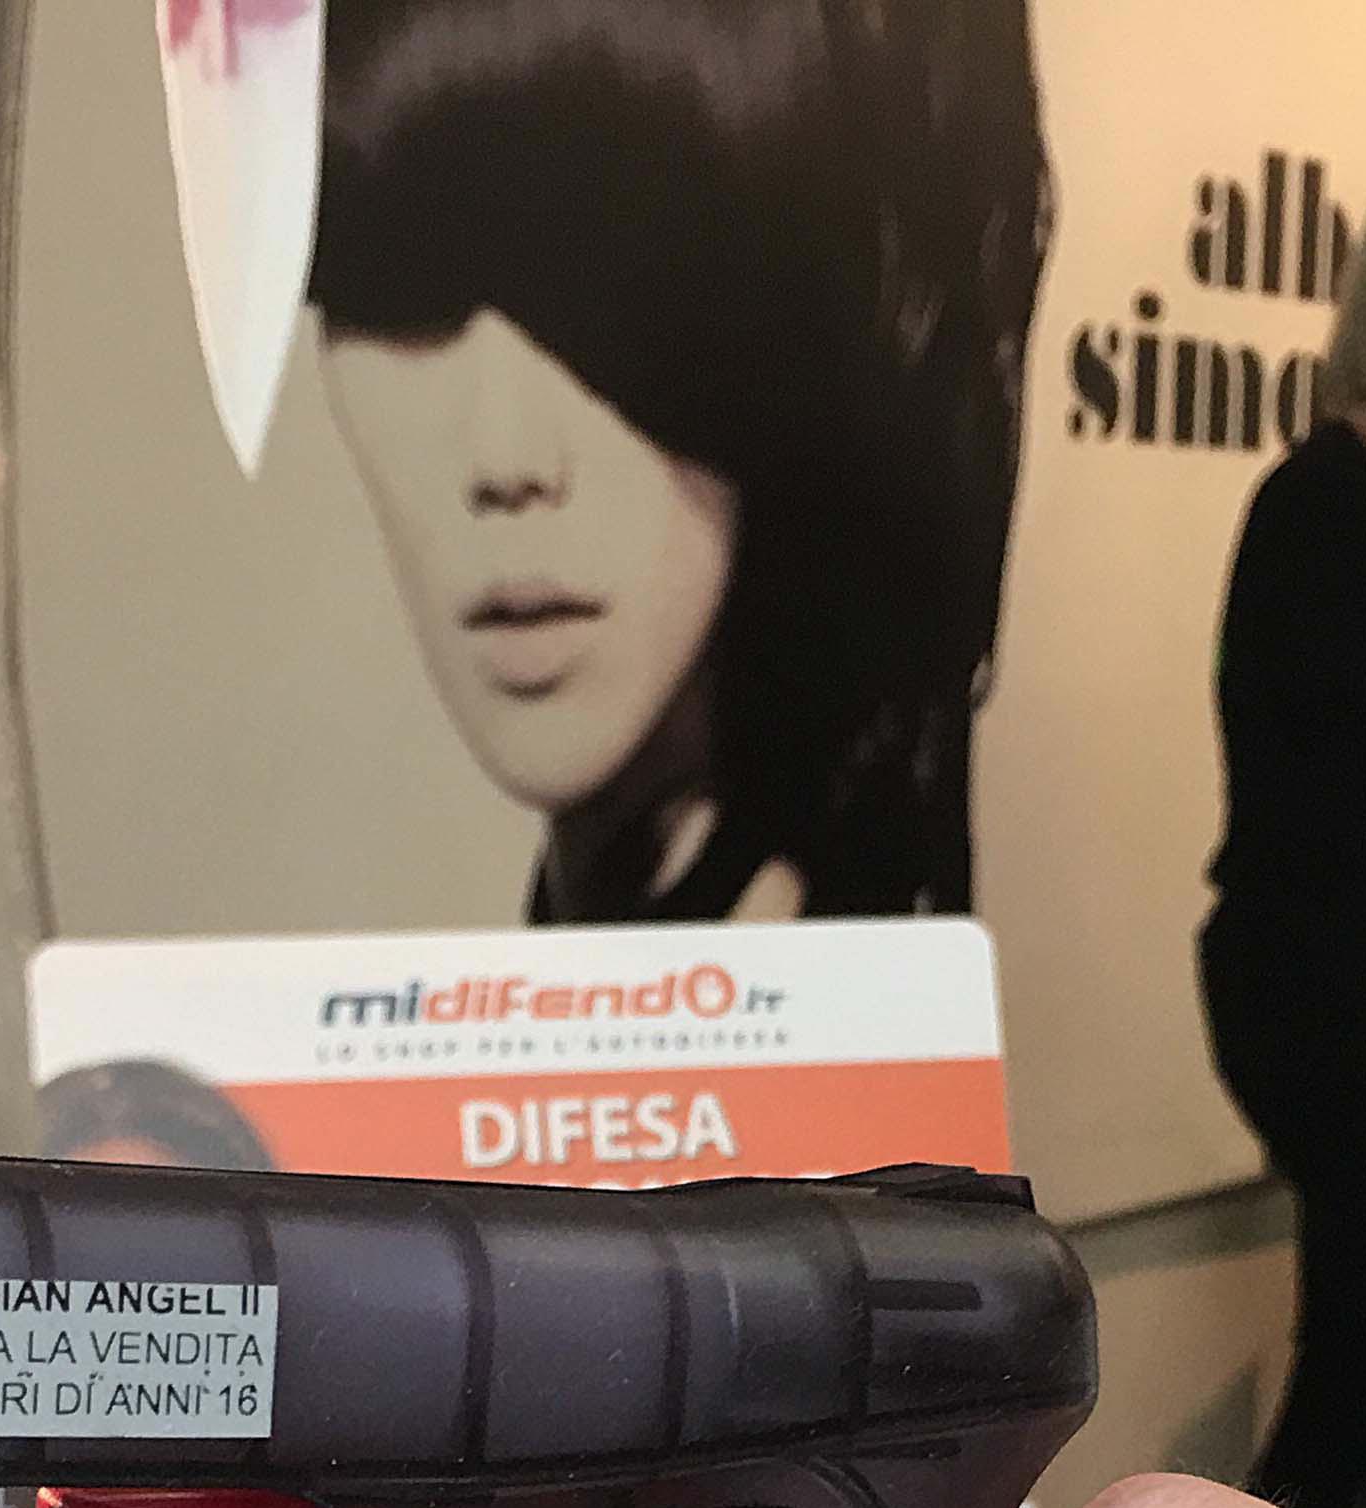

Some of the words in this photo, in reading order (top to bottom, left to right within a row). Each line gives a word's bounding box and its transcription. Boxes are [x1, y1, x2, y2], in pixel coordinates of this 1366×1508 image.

[1187, 149, 1352, 303] alb
[460, 1092, 738, 1168] DIFESA
[86, 1283, 226, 1316] ANGEL
[27, 1331, 77, 1365] LA
[90, 1331, 264, 1367] VENDITA
[55, 1381, 94, 1416] DI
[105, 1382, 205, 1417] ANNI
[219, 1384, 259, 1417] 16
